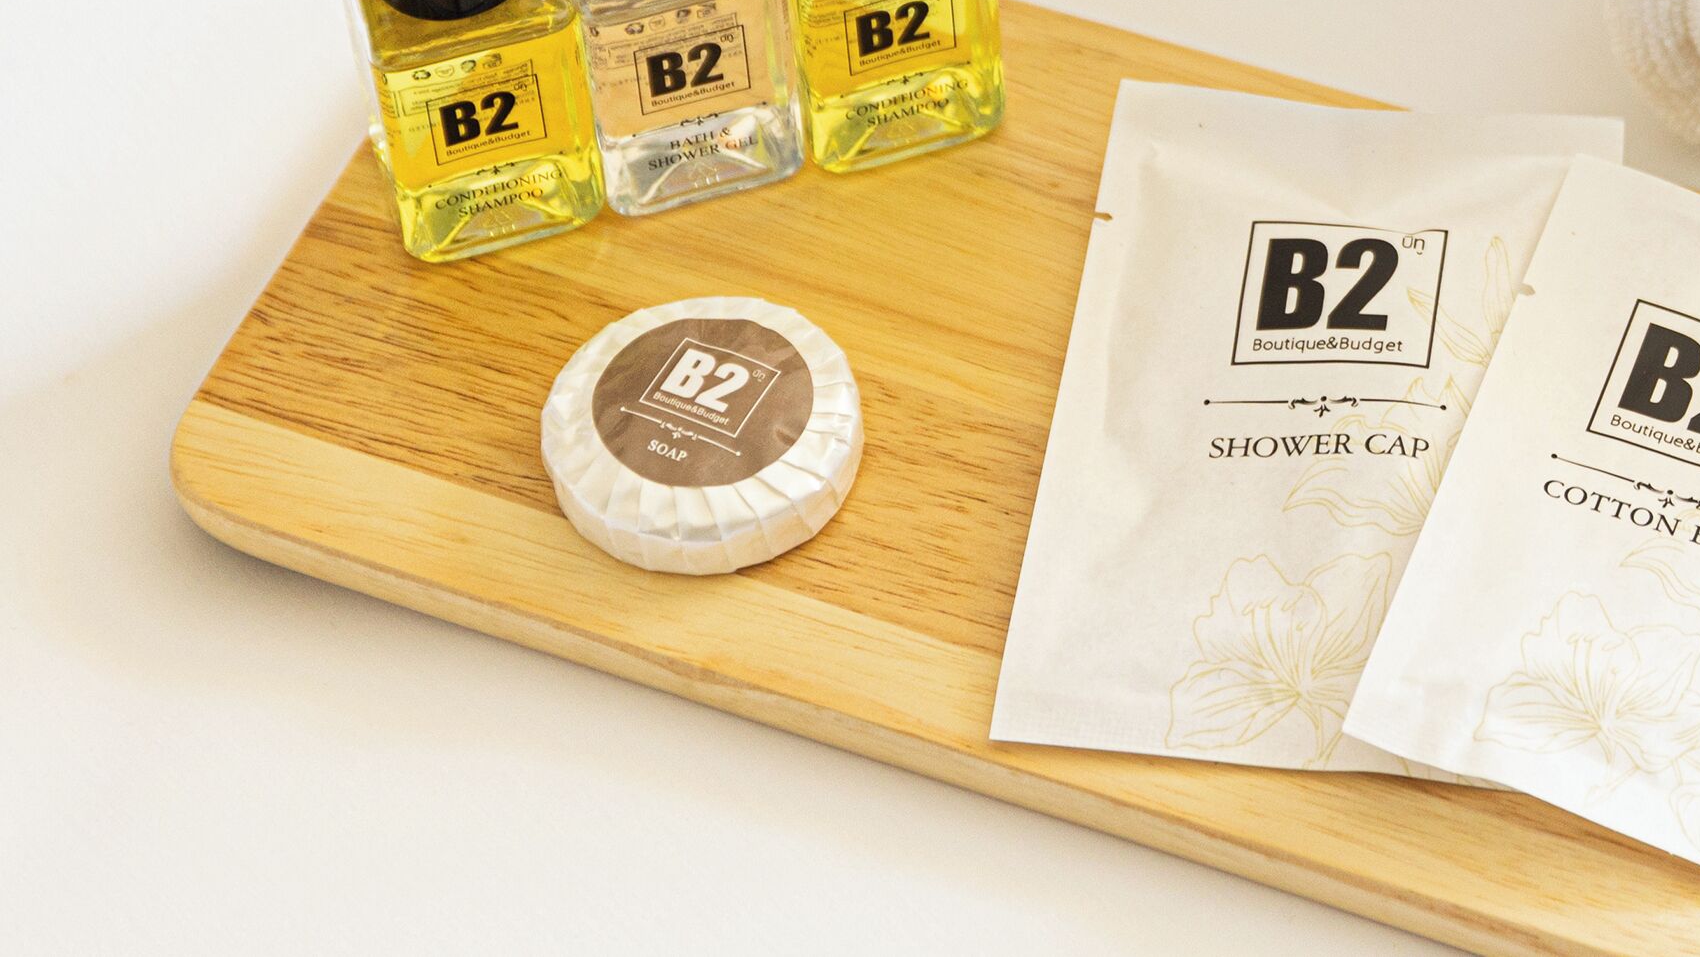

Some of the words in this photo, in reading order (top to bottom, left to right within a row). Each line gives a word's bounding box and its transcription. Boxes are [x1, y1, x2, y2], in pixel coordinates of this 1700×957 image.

[855, 0, 931, 58] B2
[645, 42, 725, 98] B2
[859, 39, 942, 67] Boutique&Budget
[651, 80, 736, 107] Boutique&Budget
[845, 80, 969, 121] CONDITIONING
[438, 91, 519, 147] B2
[866, 98, 951, 128] SHAMPOO
[446, 129, 532, 157] Boutique&Budget
[648, 143, 721, 171] SHOWER
[724, 135, 759, 151] GEL
[669, 130, 716, 150] BATH
[719, 126, 731, 138] &
[435, 169, 564, 211] CONDITIONING
[458, 187, 544, 219] SHAMPOO
[1256, 238, 1399, 331] B2
[1252, 336, 1403, 354] Boutique&Budget
[660, 348, 750, 413] B2
[652, 391, 730, 426] Boutique&Budget
[647, 439, 688, 463] SOAP
[1208, 433, 1354, 459] SHOWER
[1364, 433, 1430, 459] CAP
[1543, 479, 1682, 537] COTTON
